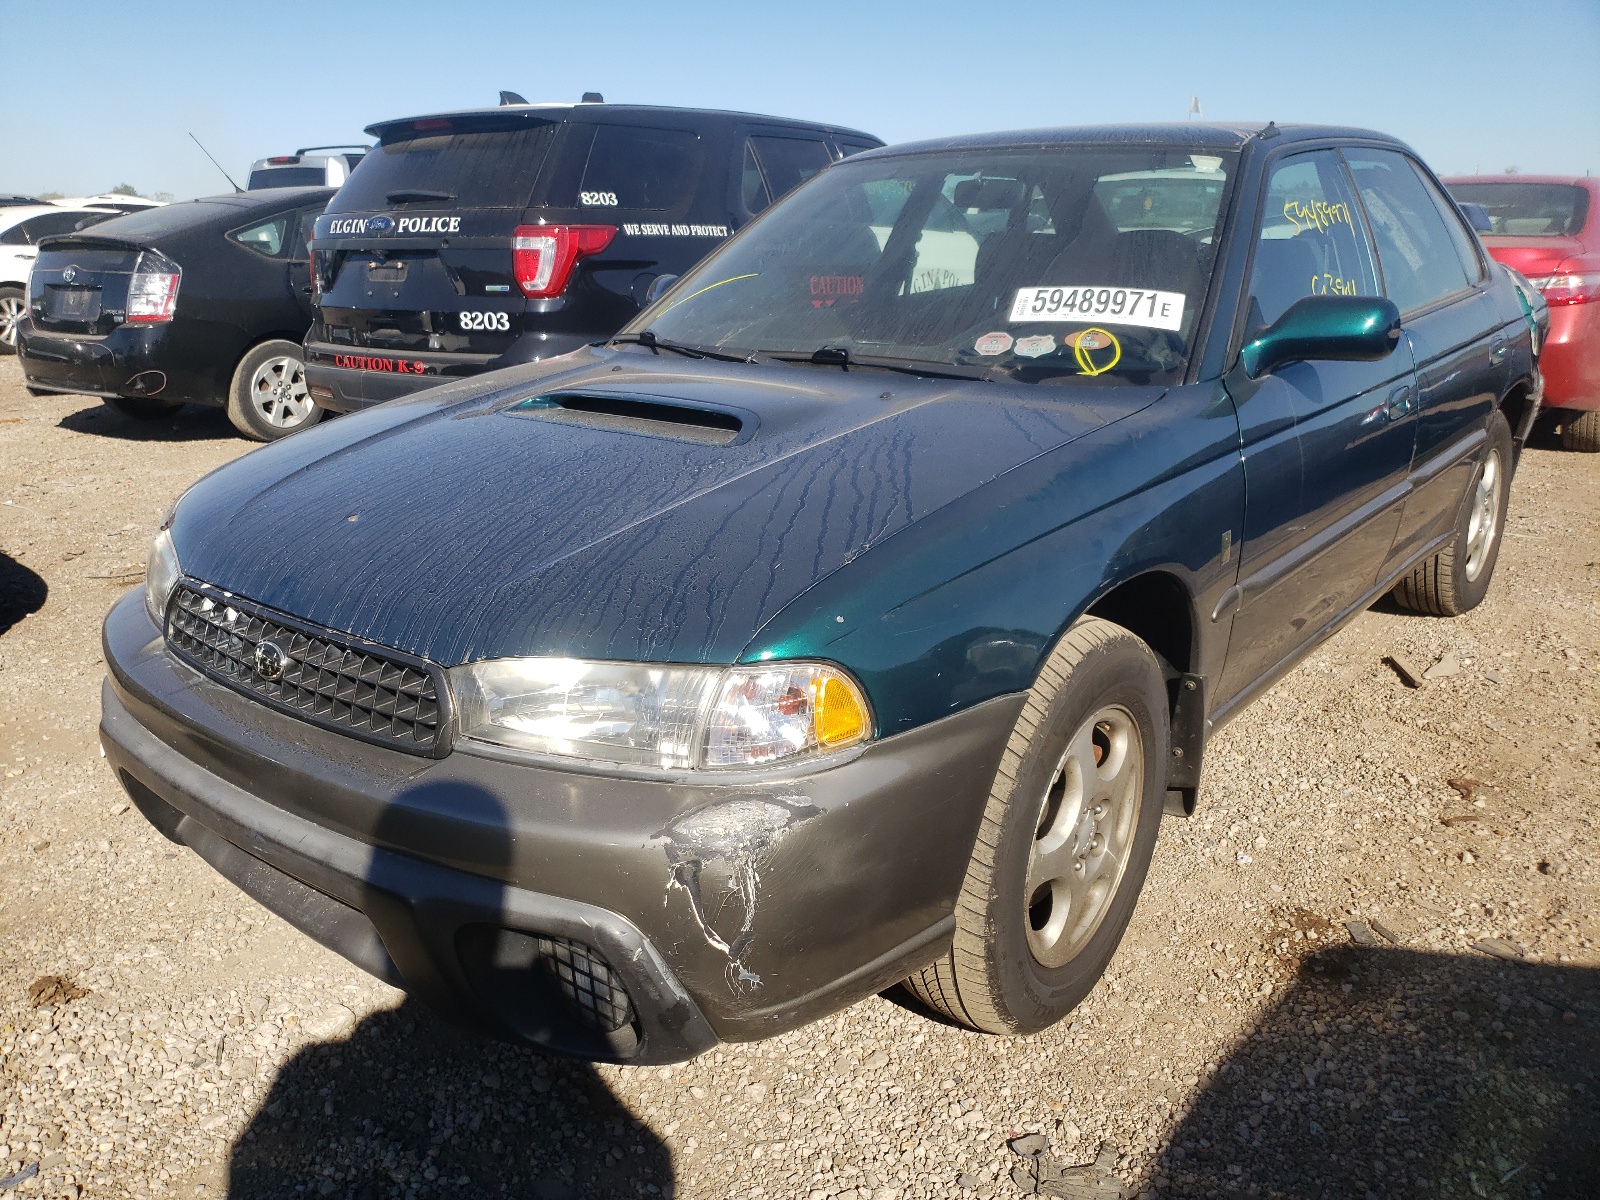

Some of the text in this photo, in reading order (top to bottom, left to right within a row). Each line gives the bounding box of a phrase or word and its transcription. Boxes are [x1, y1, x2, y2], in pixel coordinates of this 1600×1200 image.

[580, 192, 618, 205] 8203
[329, 217, 461, 234] ELGIN POLICE
[623, 223, 728, 237] WE SERVE AND PROTECT
[810, 275, 864, 295] CAUTION
[1031, 288, 1158, 318] 59489971
[1161, 303, 1172, 317] E
[459, 311, 510, 331] 8203
[335, 355, 425, 374] CAUTION K-9
